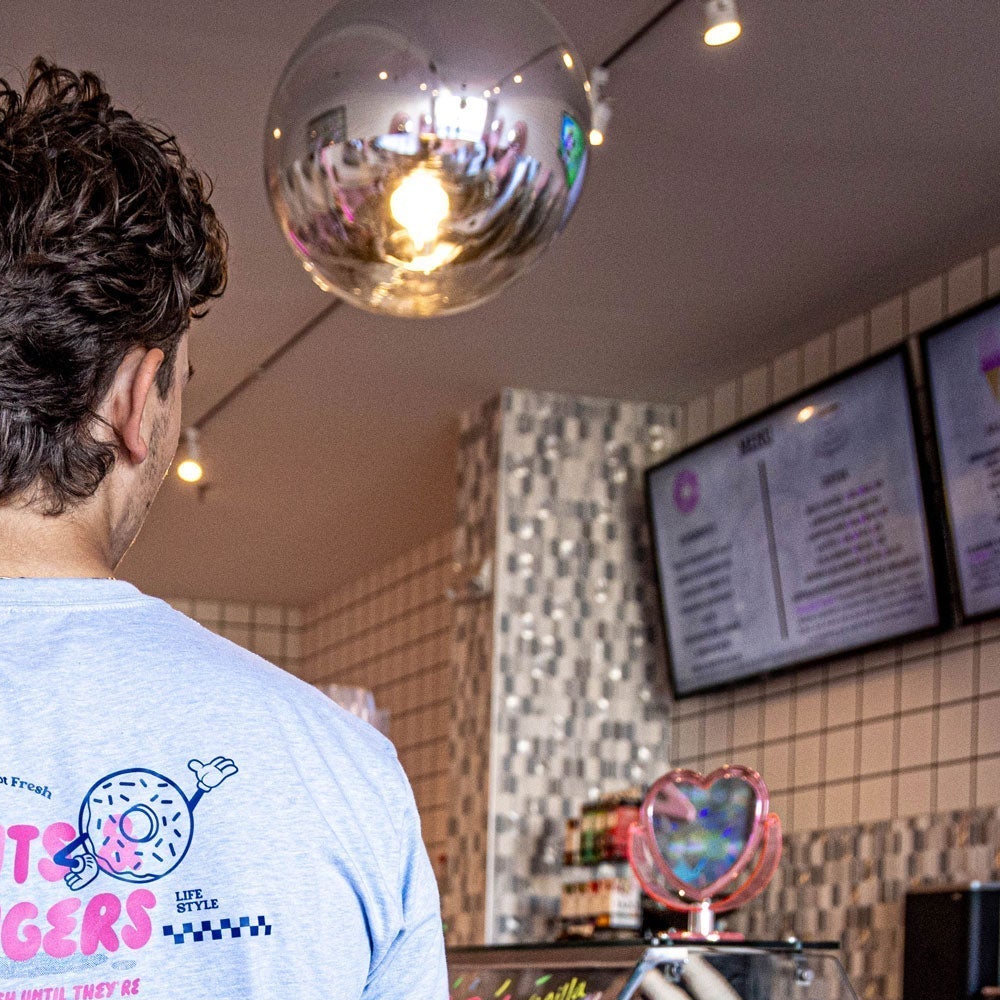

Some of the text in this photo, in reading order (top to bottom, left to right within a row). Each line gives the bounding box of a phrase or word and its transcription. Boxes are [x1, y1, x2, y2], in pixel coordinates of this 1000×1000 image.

[10, 776, 53, 800] Fresh
[175, 888, 203, 902] LIFE
[176, 898, 219, 914] STYLE
